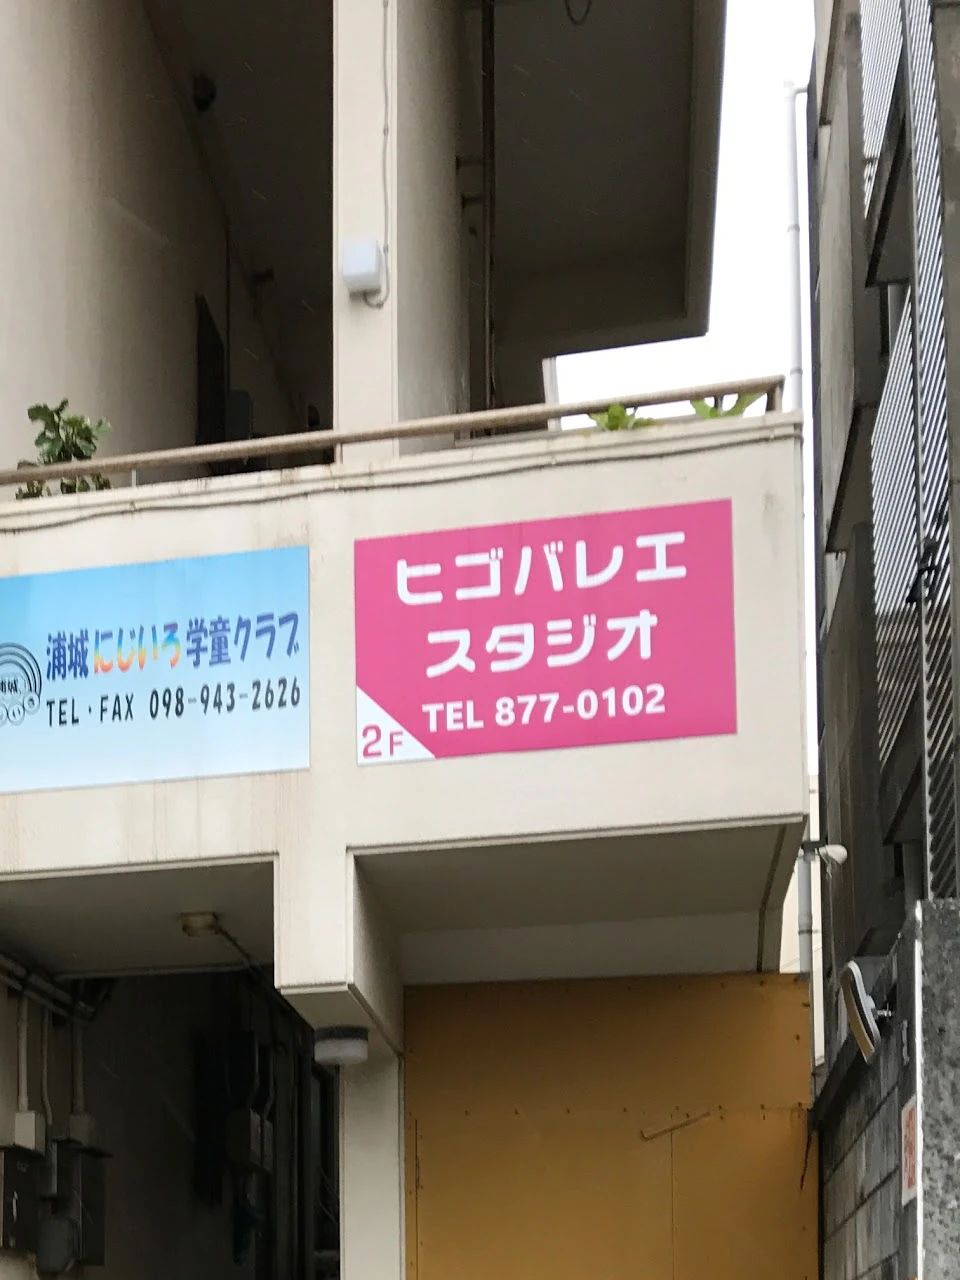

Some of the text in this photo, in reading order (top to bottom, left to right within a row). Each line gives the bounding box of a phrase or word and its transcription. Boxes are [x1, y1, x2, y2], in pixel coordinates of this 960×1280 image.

[396, 530, 688, 606] ヒゴバレエ
[46, 611, 300, 682] 浦城にじいろ学童クラブ
[426, 609, 658, 678] スタジオ
[149, 676, 301, 720] 098-943-2626
[422, 683, 666, 733] TEL 877-0102
[362, 724, 405, 759] 2F
